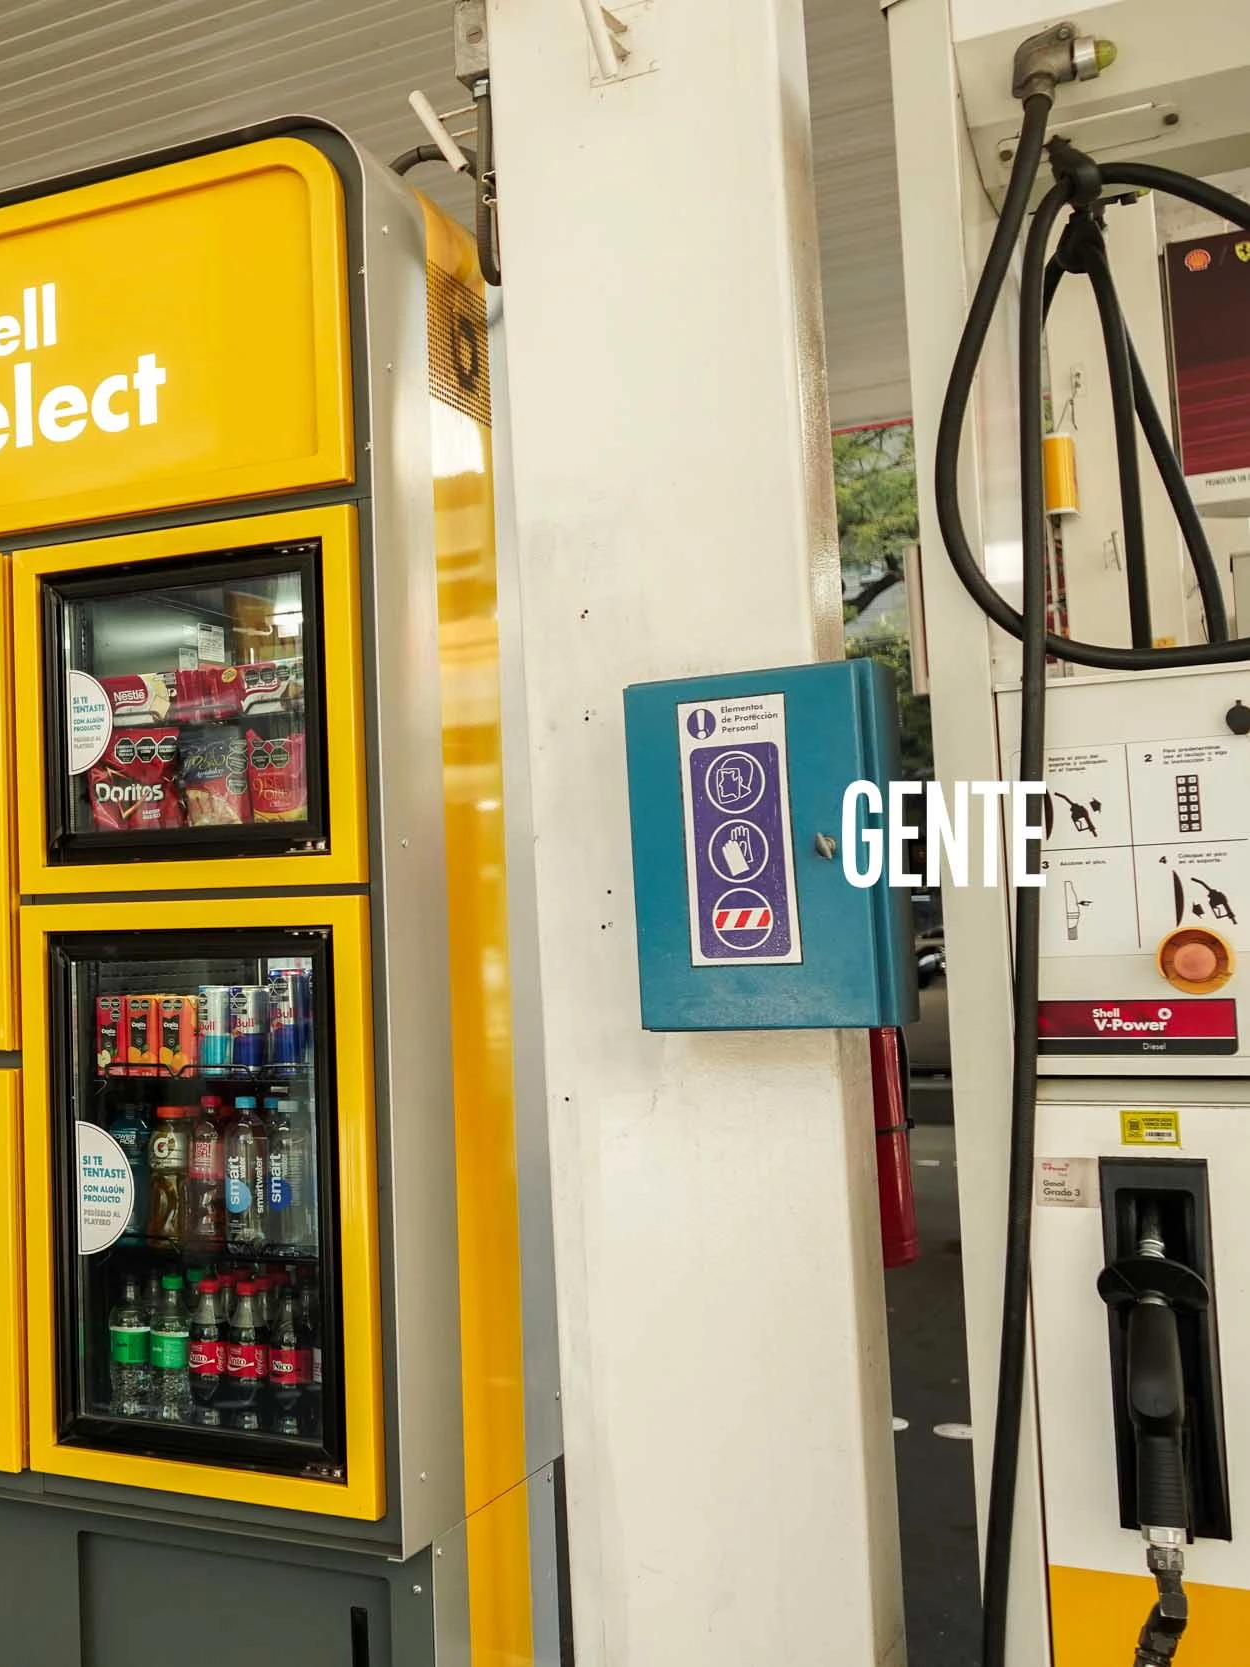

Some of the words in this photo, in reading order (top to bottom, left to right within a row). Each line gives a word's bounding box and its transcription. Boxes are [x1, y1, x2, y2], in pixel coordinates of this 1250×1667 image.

[721, 704, 764, 714] Elementos
[721, 715, 732, 723] de
[734, 711, 779, 721] Protección
[721, 722, 759, 733] Personal
[1144, 753, 1153, 763] 2
[95, 783, 165, 802] Doritos
[1041, 860, 1050, 870] 3
[1158, 855, 1167, 864] 4
[1092, 1007, 1121, 1018] Shell
[236, 1017, 255, 1028] Bull
[1093, 1018, 1168, 1031] V-Power
[1142, 1042, 1167, 1050] Diesel
[82, 1155, 92, 1165] SI
[93, 1155, 103, 1166] TE
[239, 1156, 247, 1178] water
[82, 1167, 126, 1179] TENTASTE
[270, 1152, 282, 1203] smart
[228, 1155, 240, 1205] smart
[255, 1155, 264, 1214] smartwater
[83, 1184, 99, 1193] CON
[100, 1184, 125, 1194] ALGÚN
[1043, 1187, 1072, 1196] Grado
[1074, 1188, 1081, 1197] 3
[83, 1194, 121, 1203] PRODUCTO
[272, 1359, 294, 1373] Nico
